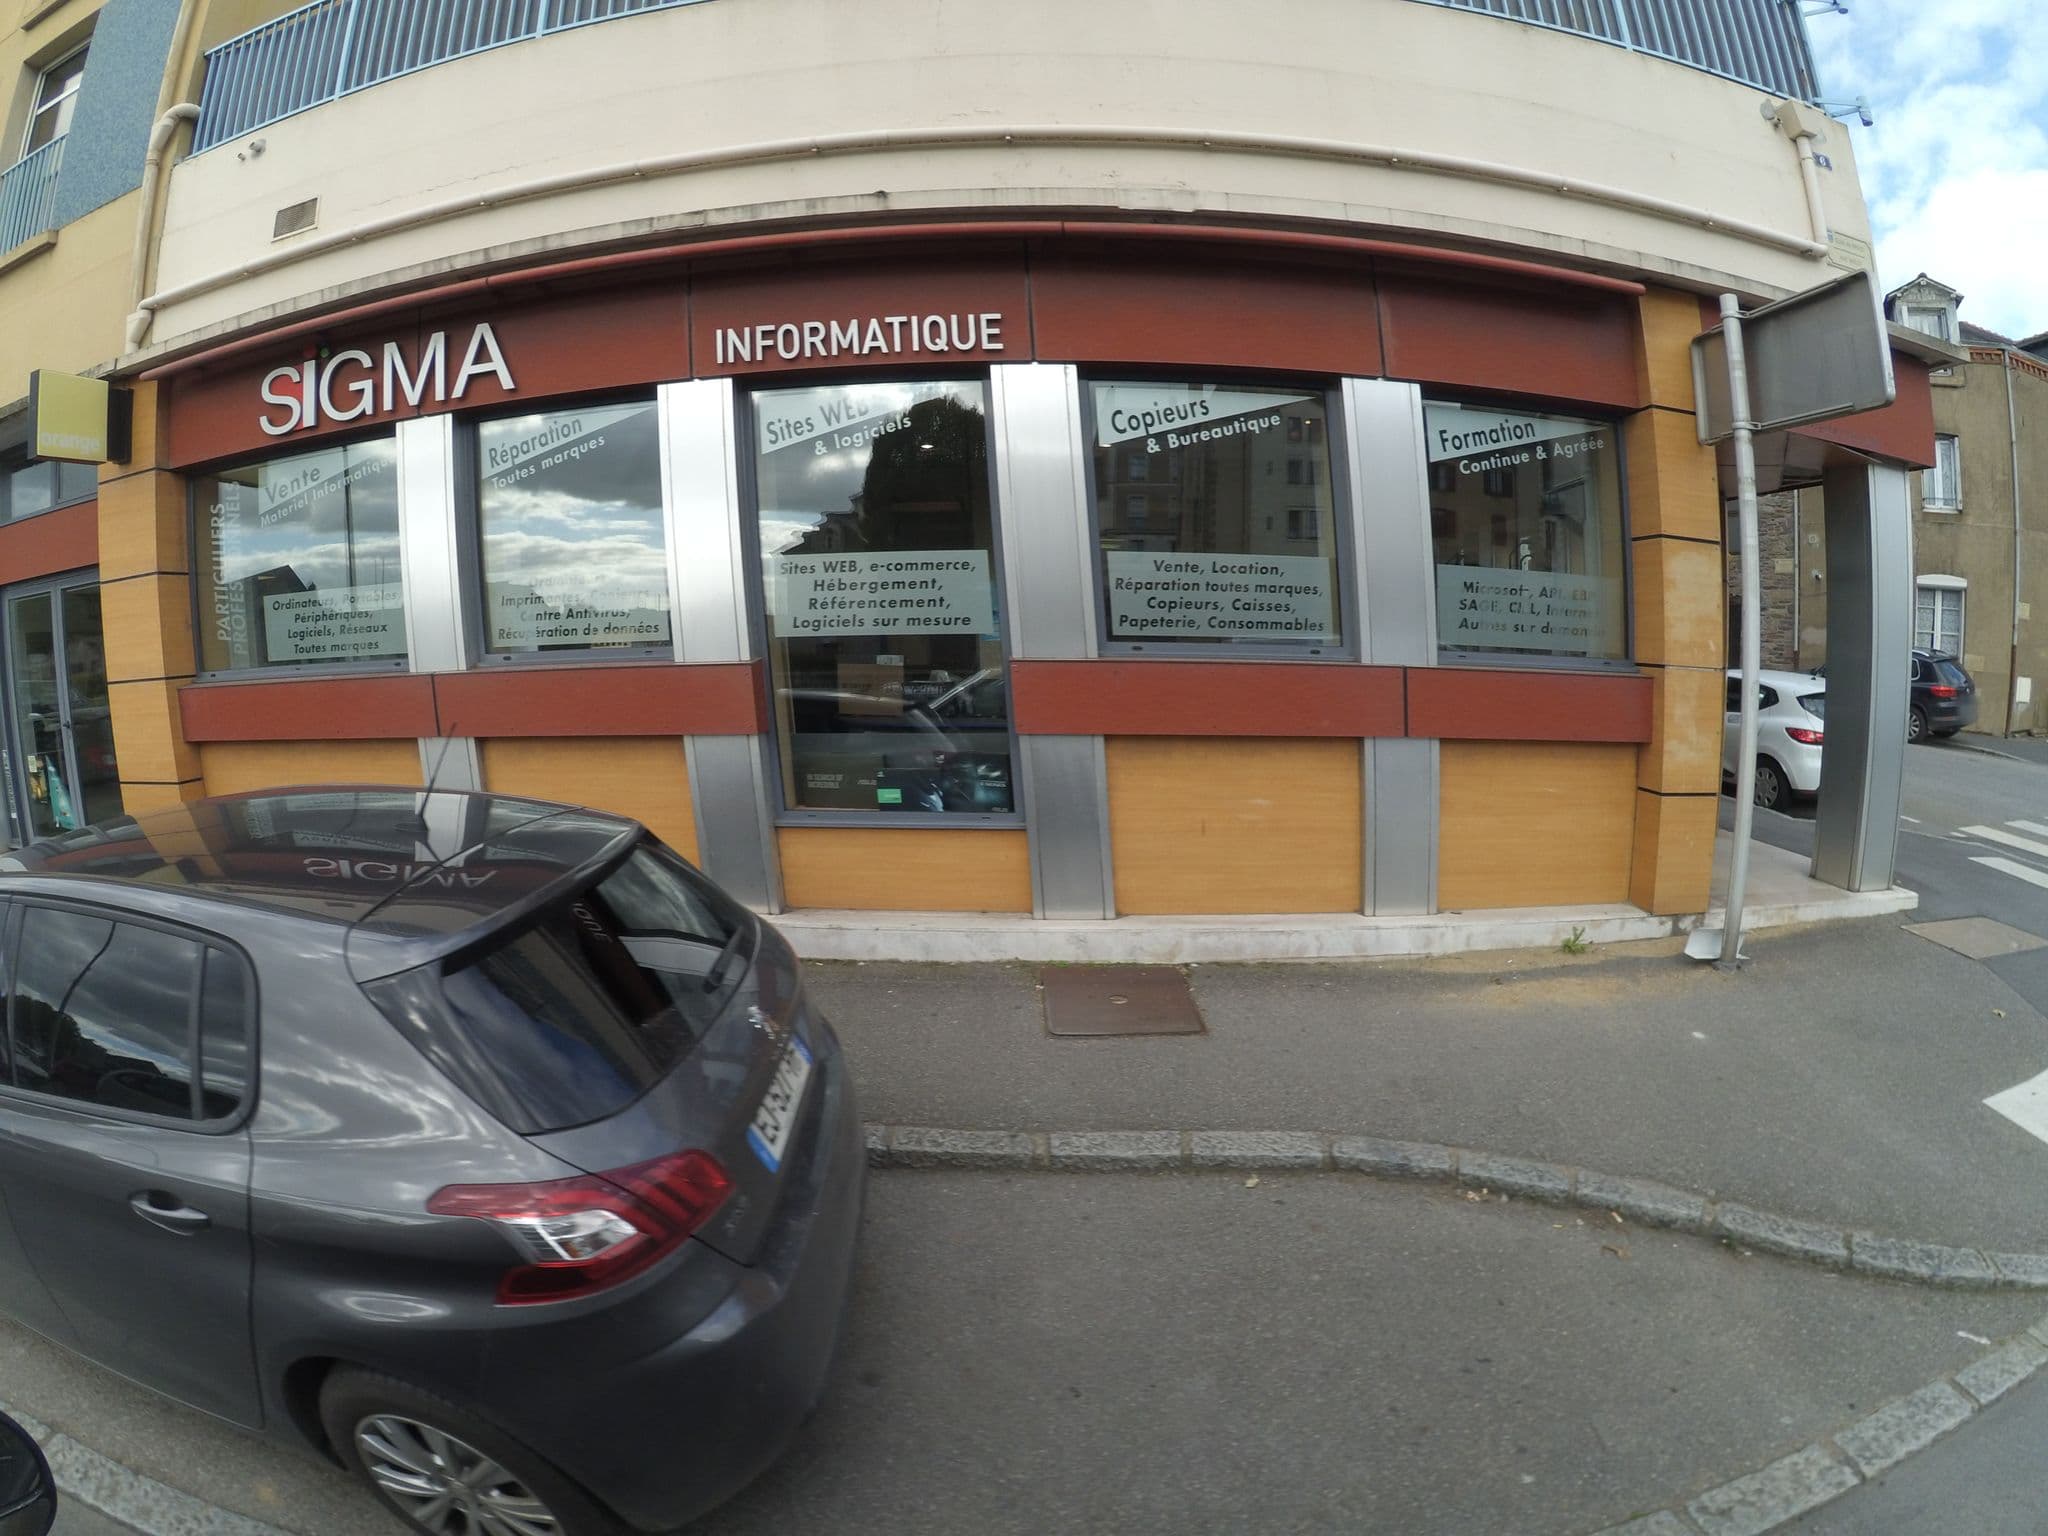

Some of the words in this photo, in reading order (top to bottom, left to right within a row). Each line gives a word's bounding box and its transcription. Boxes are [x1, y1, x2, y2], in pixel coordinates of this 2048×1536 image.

[716, 313, 1004, 363] INFORMATIQUE
[259, 322, 516, 436] SIGMA
[1111, 399, 1210, 435] Copieurs
[766, 415, 814, 445] Sites
[815, 439, 828, 455] &
[834, 415, 912, 449] logiciels
[1146, 438, 1161, 454] &
[1168, 414, 1281, 448] Bureautique
[1439, 419, 1536, 452] Formation
[488, 417, 583, 469] Réparation
[492, 464, 536, 489] Toutes
[541, 435, 605, 469] marques
[1459, 451, 1530, 474] Continue
[1535, 446, 1547, 460] &
[1553, 436, 1604, 458] Agréée
[264, 467, 320, 503] Vente
[210, 503, 231, 640] PARTICULIERS
[223, 480, 249, 655] PROFESONNELS
[780, 562, 816, 575] Sites
[823, 560, 863, 574] WEB,
[870, 559, 976, 572] e-commerce,
[1153, 560, 1205, 575] Vente,
[1212, 561, 1285, 577] Location,
[814, 578, 943, 593] Hébergement,
[1115, 577, 1200, 593] Réparation
[1206, 581, 1249, 593] toutes
[1254, 584, 1323, 598] marques,
[809, 596, 951, 609] Référencement,
[1147, 597, 1224, 613] Copieurs,
[1232, 598, 1296, 615] Caisses,
[1509, 601, 1541, 616] CIL,
[294, 611, 373, 624] Périphériques,
[521, 609, 561, 621] Cntre
[793, 614, 865, 632] Logiciels
[872, 616, 899, 627] sur
[906, 616, 972, 627] mesure
[1119, 614, 1200, 631] Papeterie,
[1208, 616, 1324, 632] Consommables
[288, 626, 335, 640] Logiciels,
[339, 624, 387, 636] Réseaux
[498, 625, 578, 640] Récuération
[583, 622, 599, 635] de
[603, 621, 660, 634] données
[294, 643, 327, 654] Toutes
